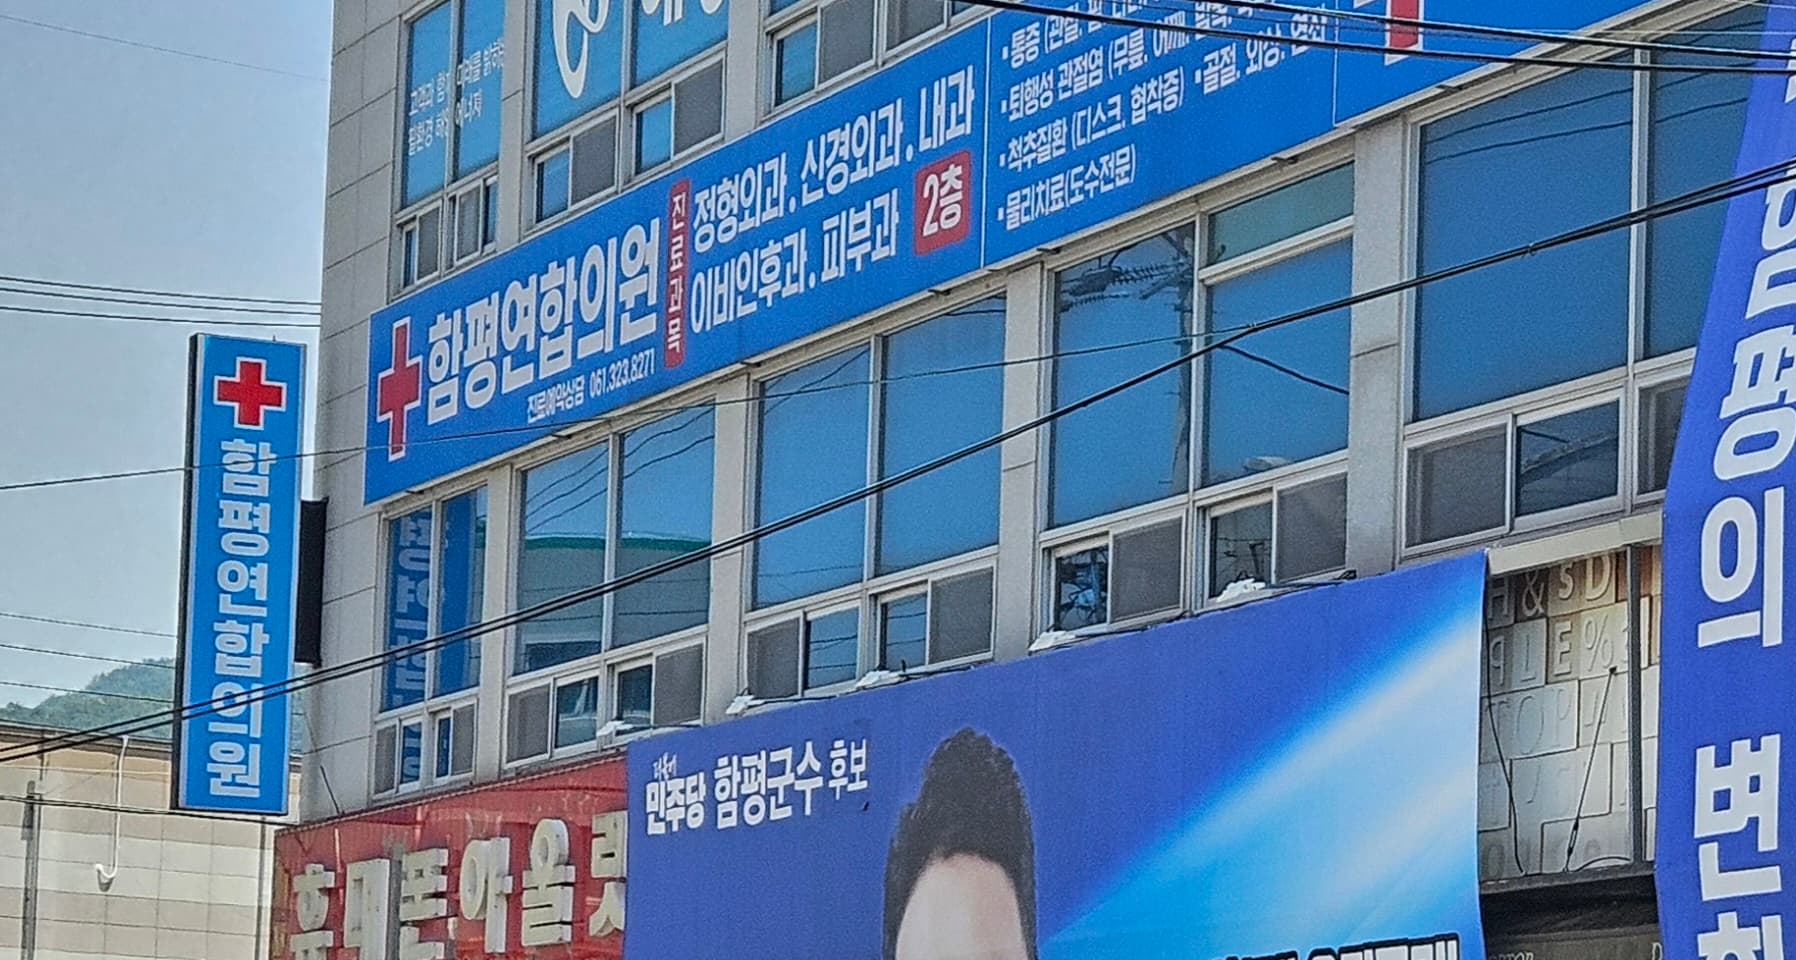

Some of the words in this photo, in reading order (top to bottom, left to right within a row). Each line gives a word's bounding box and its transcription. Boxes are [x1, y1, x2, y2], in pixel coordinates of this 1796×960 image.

[1008, 68, 1055, 122] 퇴행성
[1057, 46, 1104, 98] 관절염
[1010, 22, 1041, 69] 통증
[919, 65, 976, 152] 내과
[1007, 118, 1068, 173] 척추질환
[1131, 66, 1186, 125] 협착증)
[1203, 43, 1241, 95] 골절,
[922, 164, 964, 238] 2층
[1006, 144, 1137, 231] 물리치료(도수전문)
[664, 192, 688, 355] 진료과목
[821, 188, 900, 284] 피부과
[427, 217, 661, 427] 함평연합의원
[589, 348, 657, 400] 061.323.8271
[208, 438, 277, 799] 함평연합의원
[645, 771, 707, 835] 민주당
[714, 741, 824, 830] 함평군수
[828, 738, 869, 801] 후보
